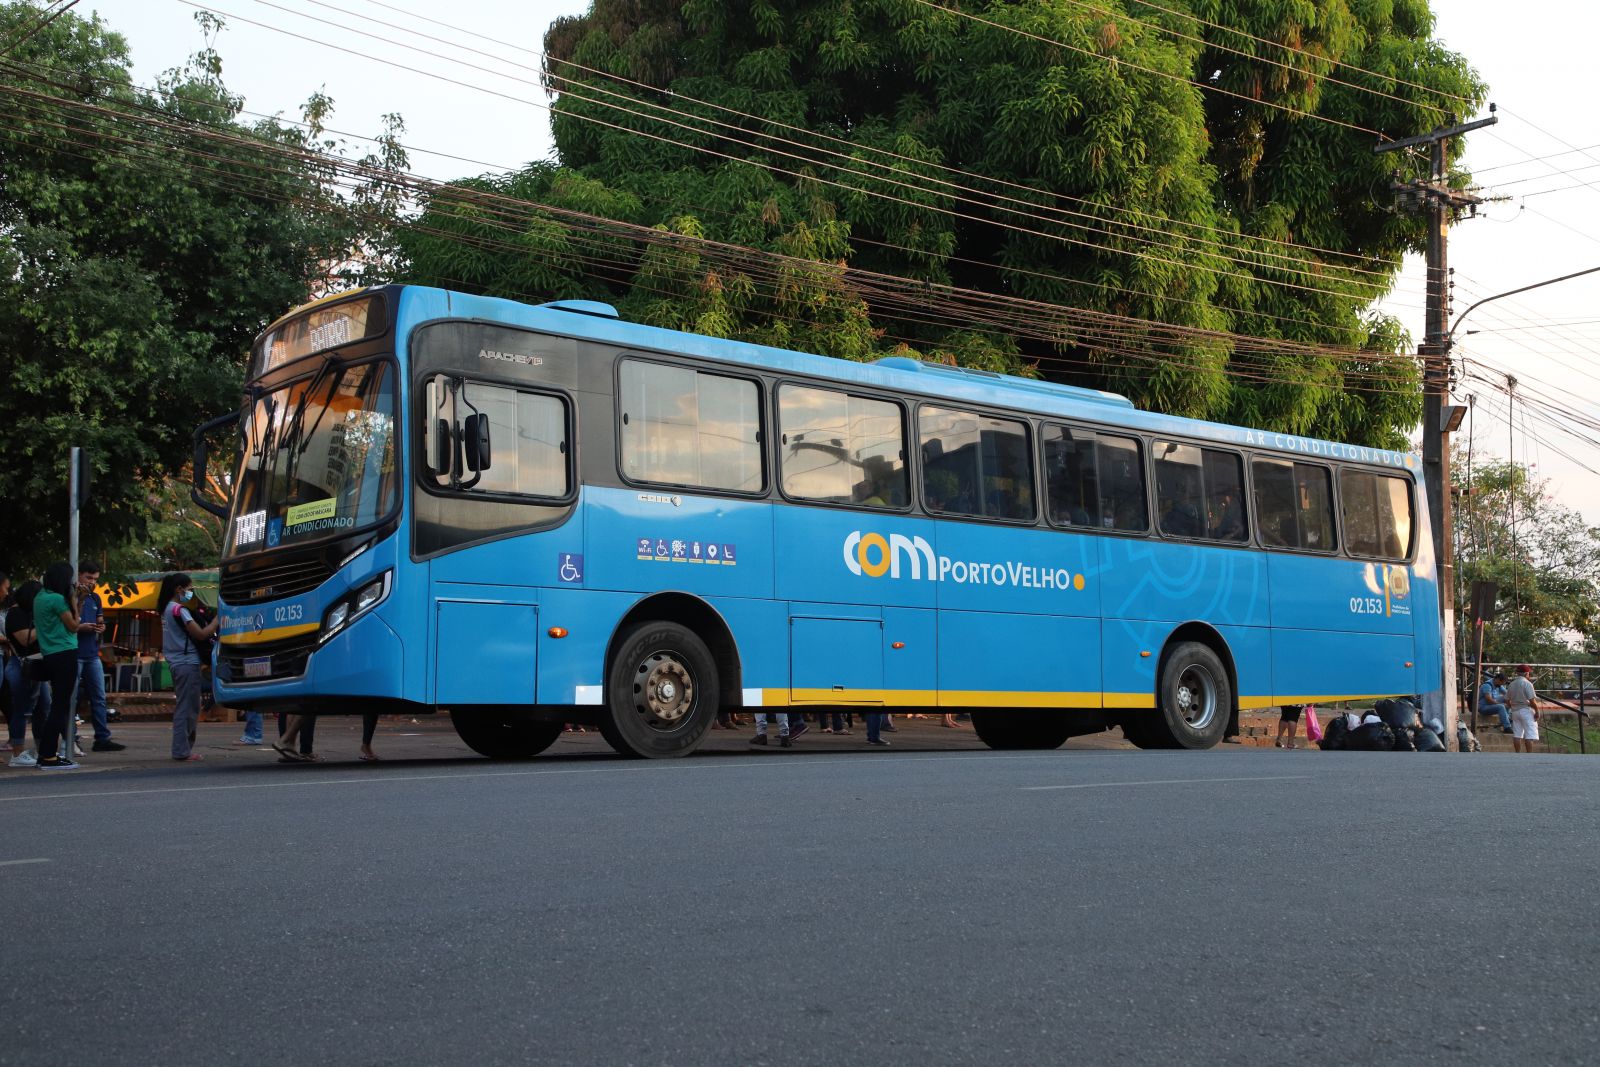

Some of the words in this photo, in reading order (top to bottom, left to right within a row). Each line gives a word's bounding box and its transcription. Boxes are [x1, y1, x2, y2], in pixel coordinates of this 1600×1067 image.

[1246, 430, 1265, 446] AR
[1275, 435, 1402, 466] CONDICIONADO
[282, 526, 291, 537] AR
[293, 517, 354, 535] CONDICIONADO
[274, 604, 303, 622] 02.153
[1349, 597, 1383, 615] 02.153
